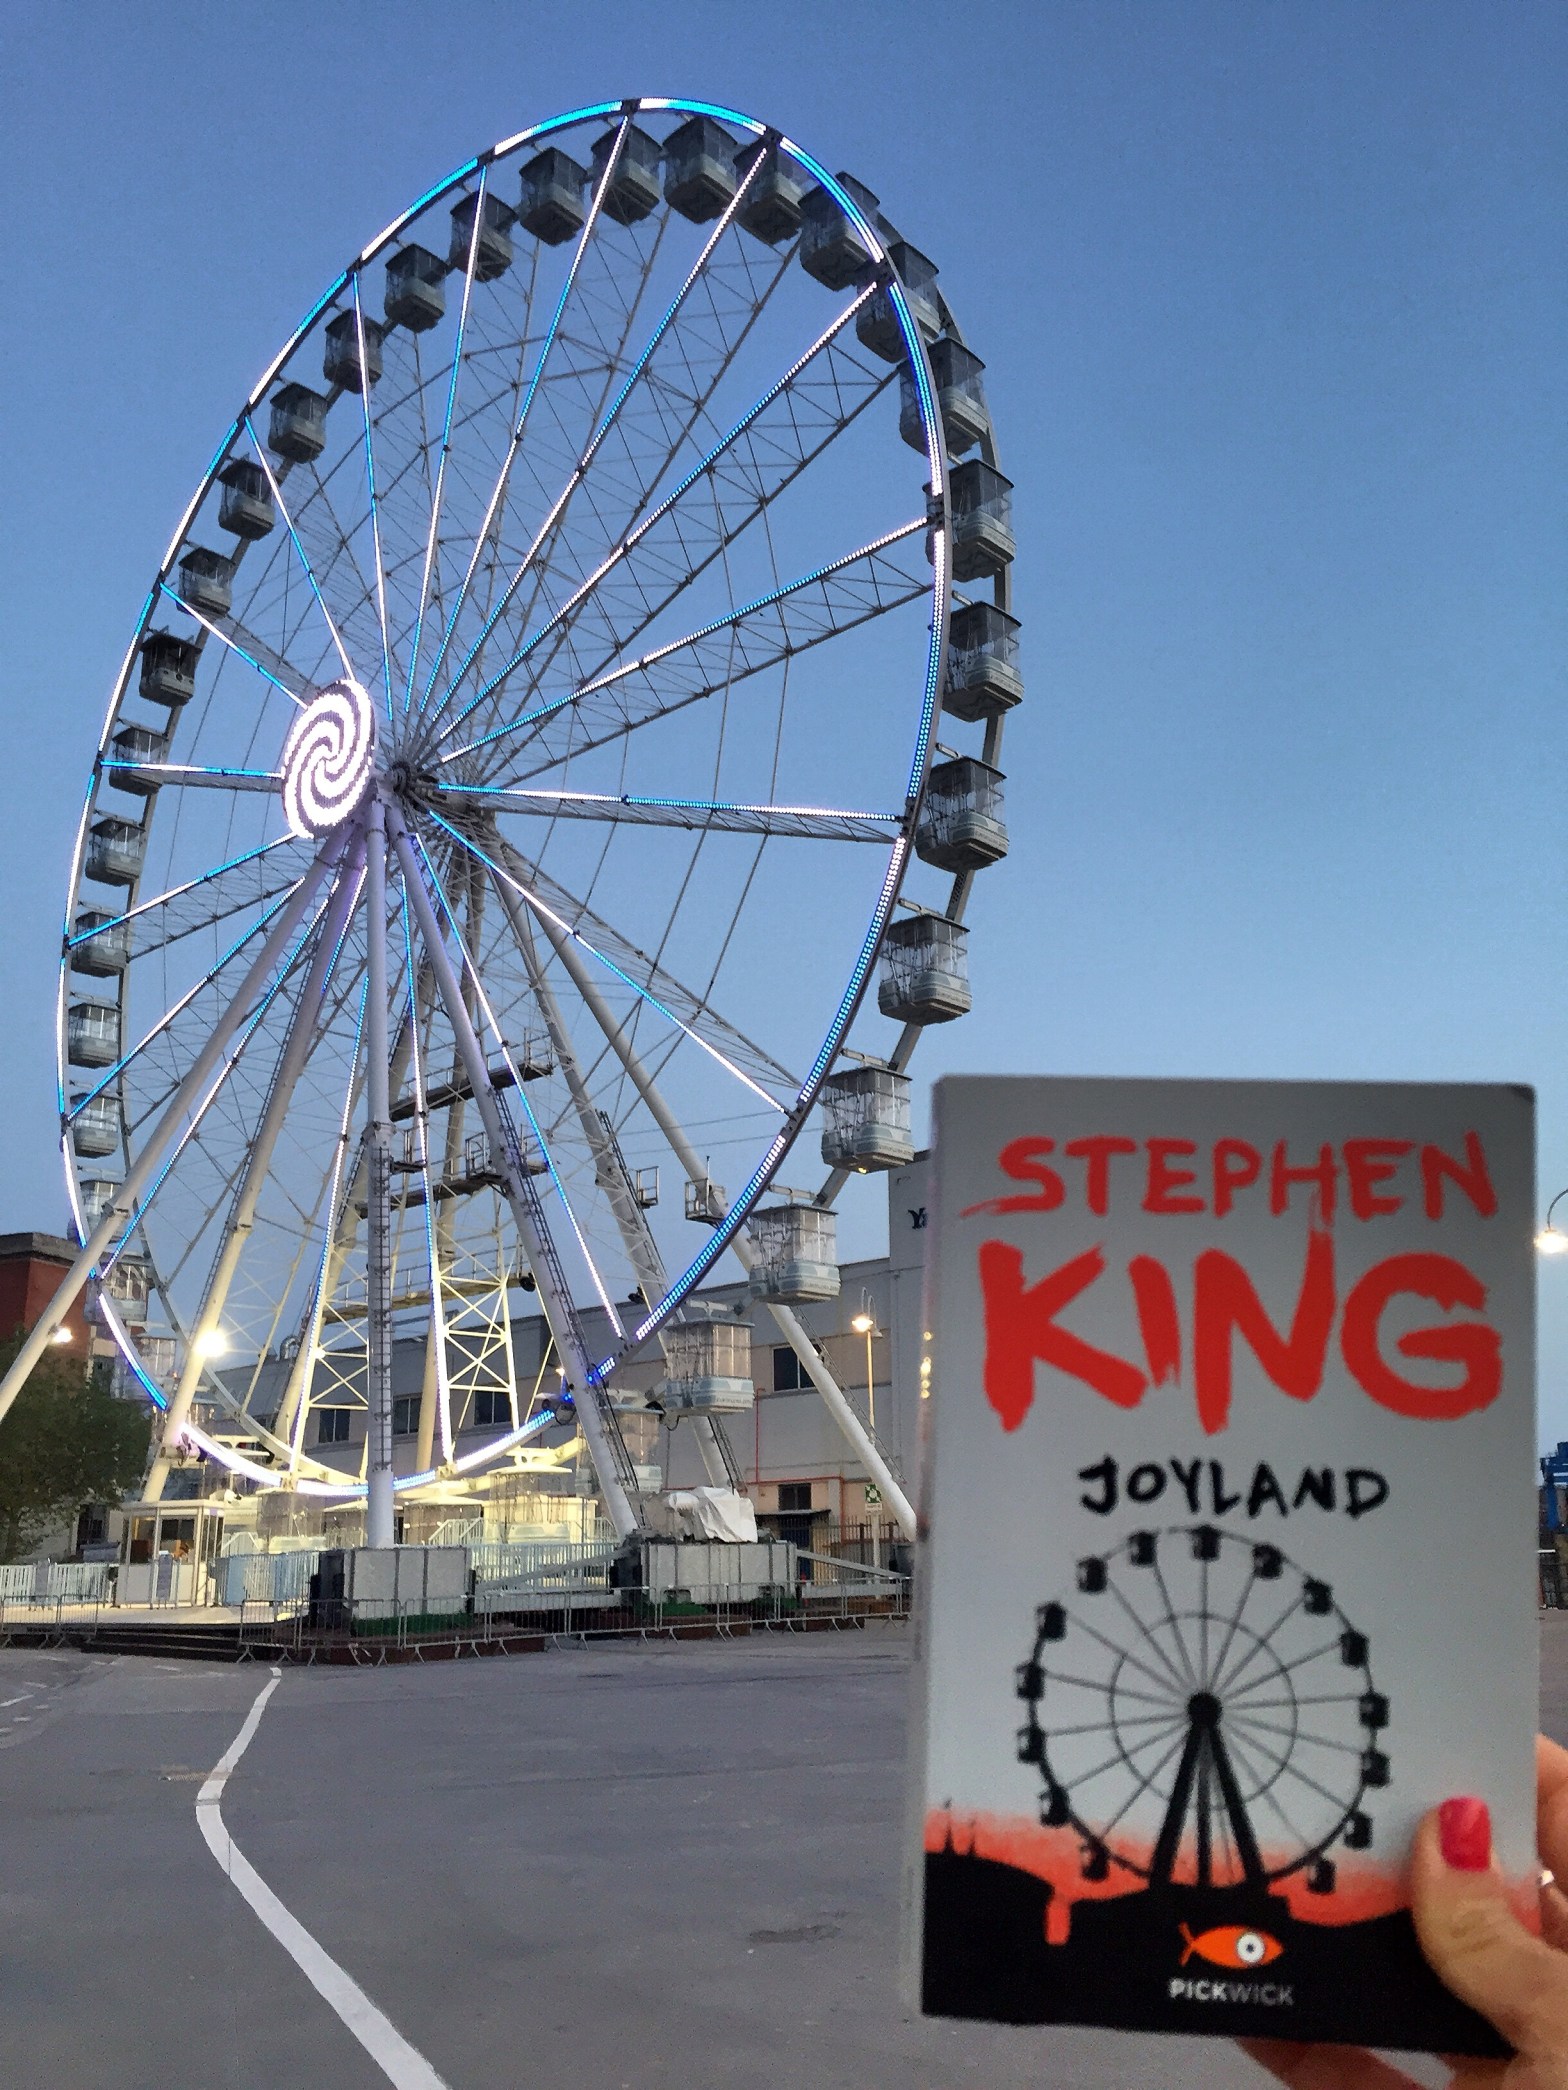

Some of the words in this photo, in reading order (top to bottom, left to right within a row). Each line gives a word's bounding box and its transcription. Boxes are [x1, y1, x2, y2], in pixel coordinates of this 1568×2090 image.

[959, 1130, 1498, 1222] STEPHEN
[977, 1224, 1502, 1435] KING
[1078, 1455, 1390, 1518] JOYLAND
[1168, 1977, 1294, 2006] PICKWICK
